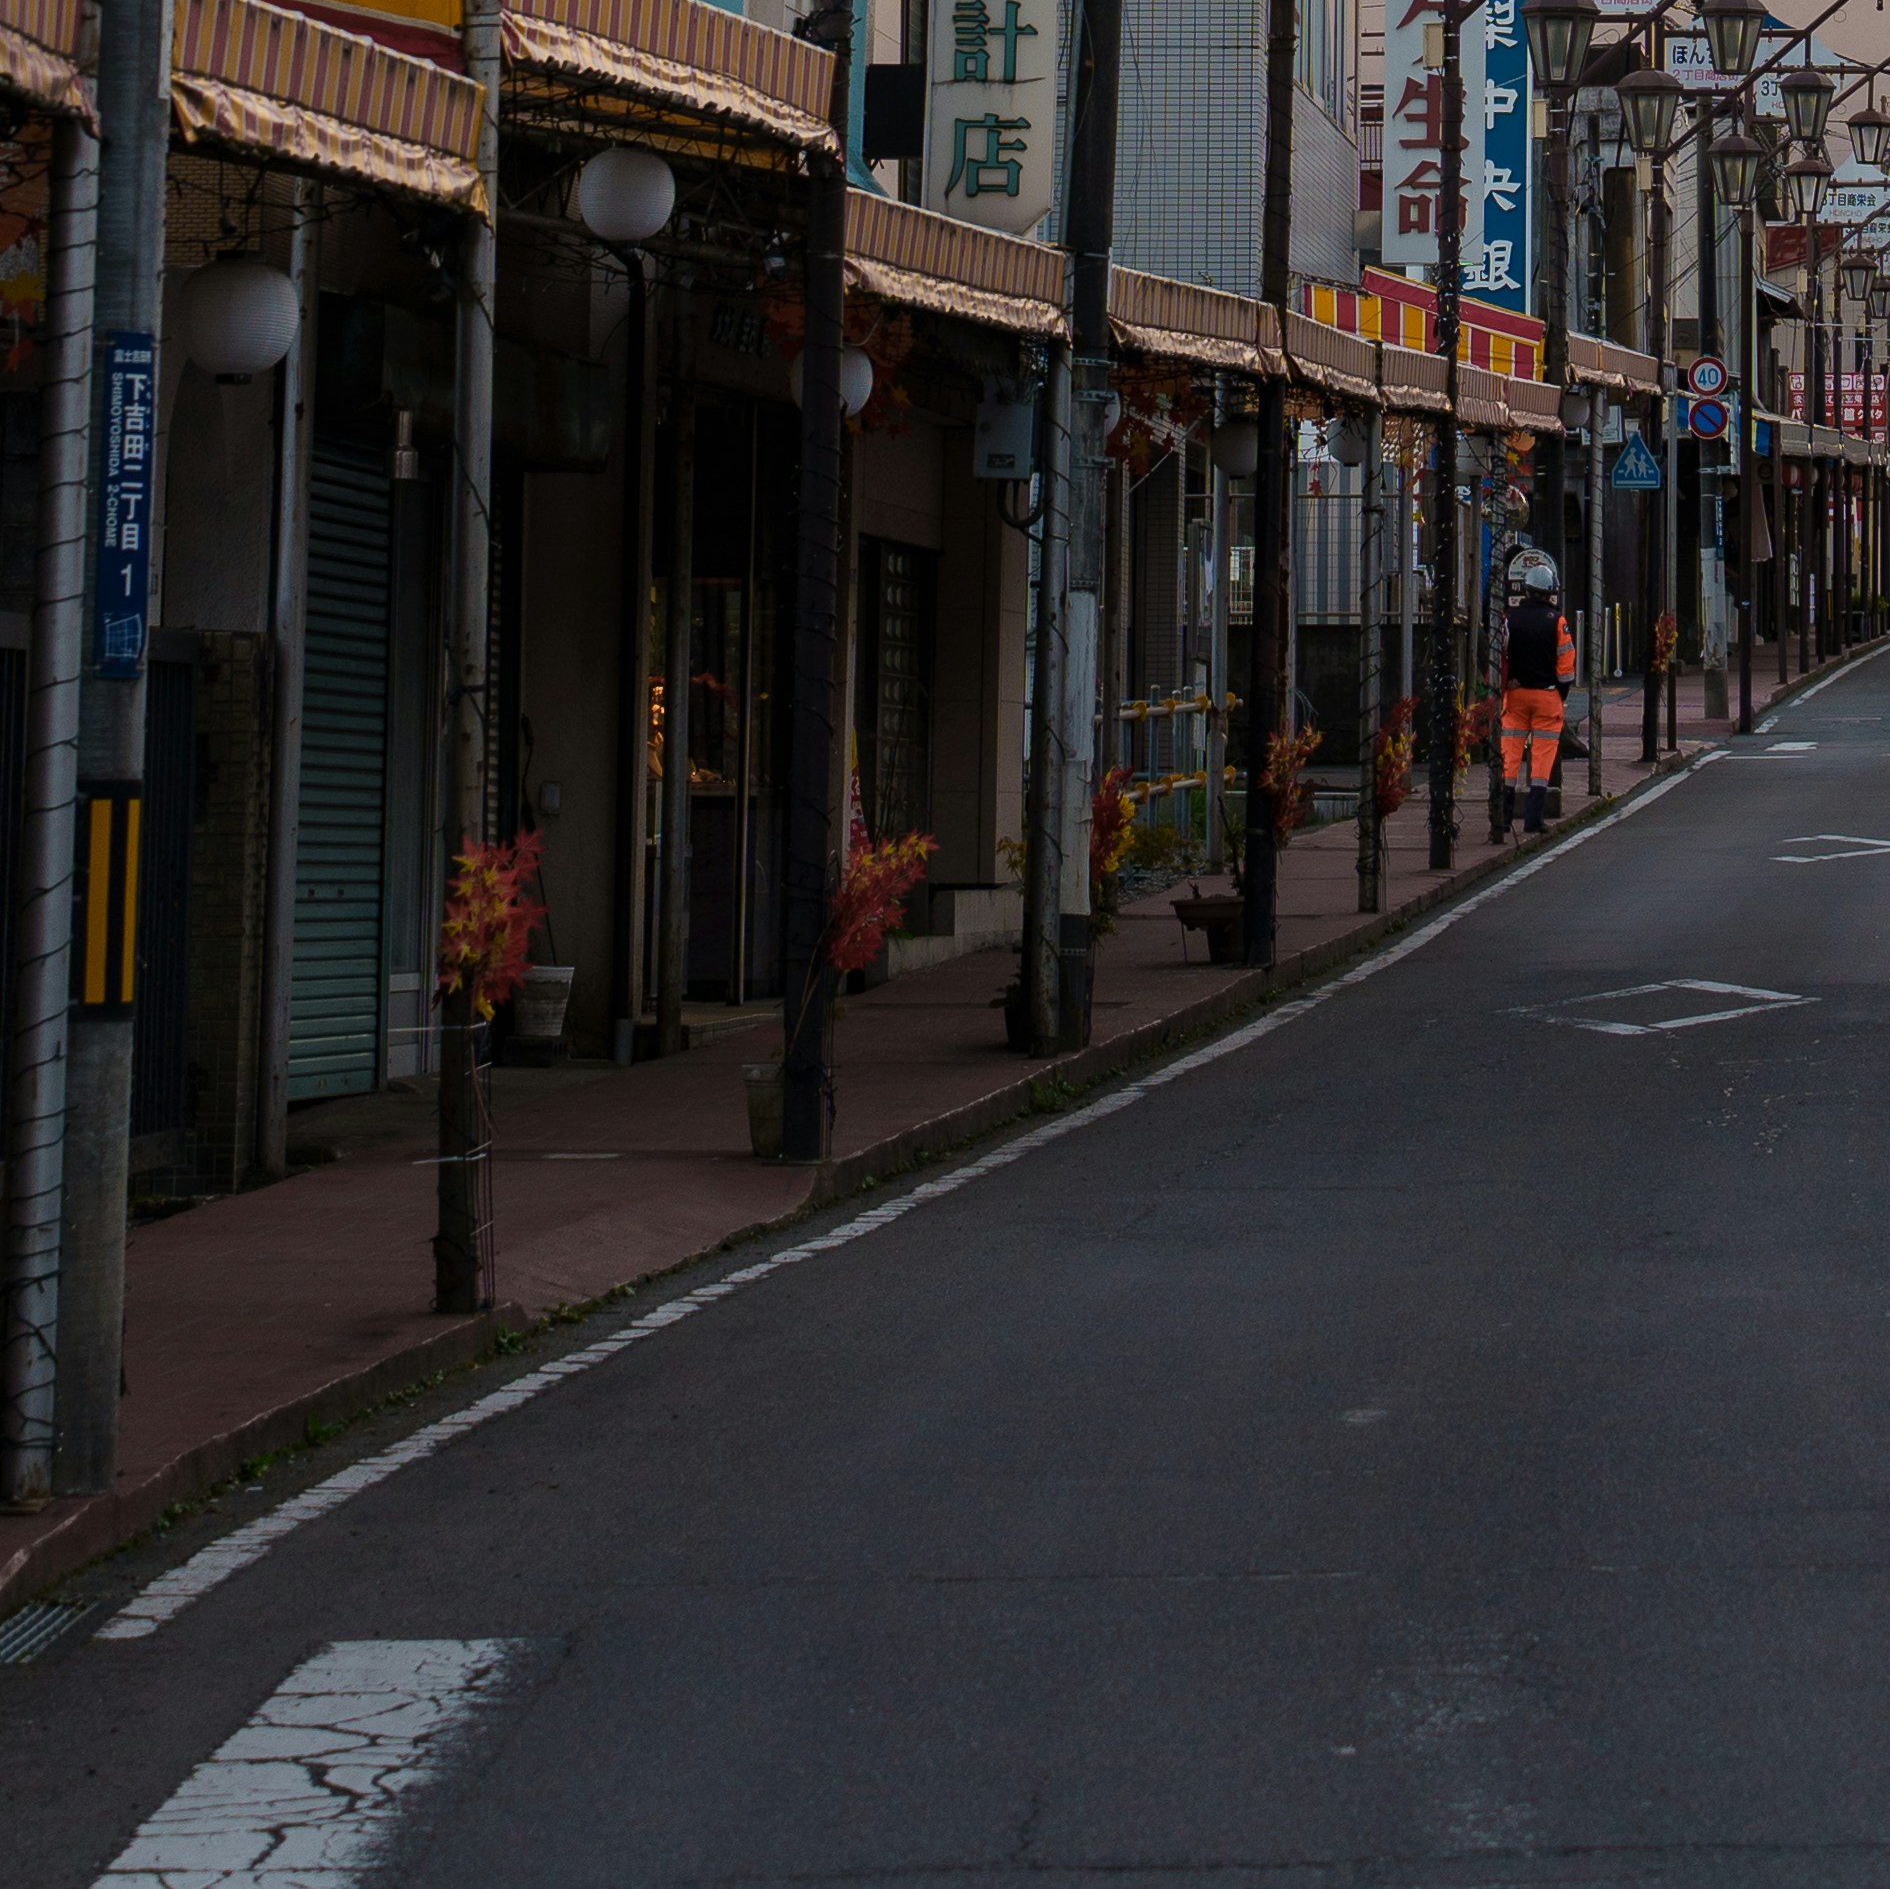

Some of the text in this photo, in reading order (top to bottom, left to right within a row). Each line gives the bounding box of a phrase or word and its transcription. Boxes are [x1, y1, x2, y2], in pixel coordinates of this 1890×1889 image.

[1697, 368, 1719, 386] 40
[121, 373, 148, 551] 下吉田二丁目
